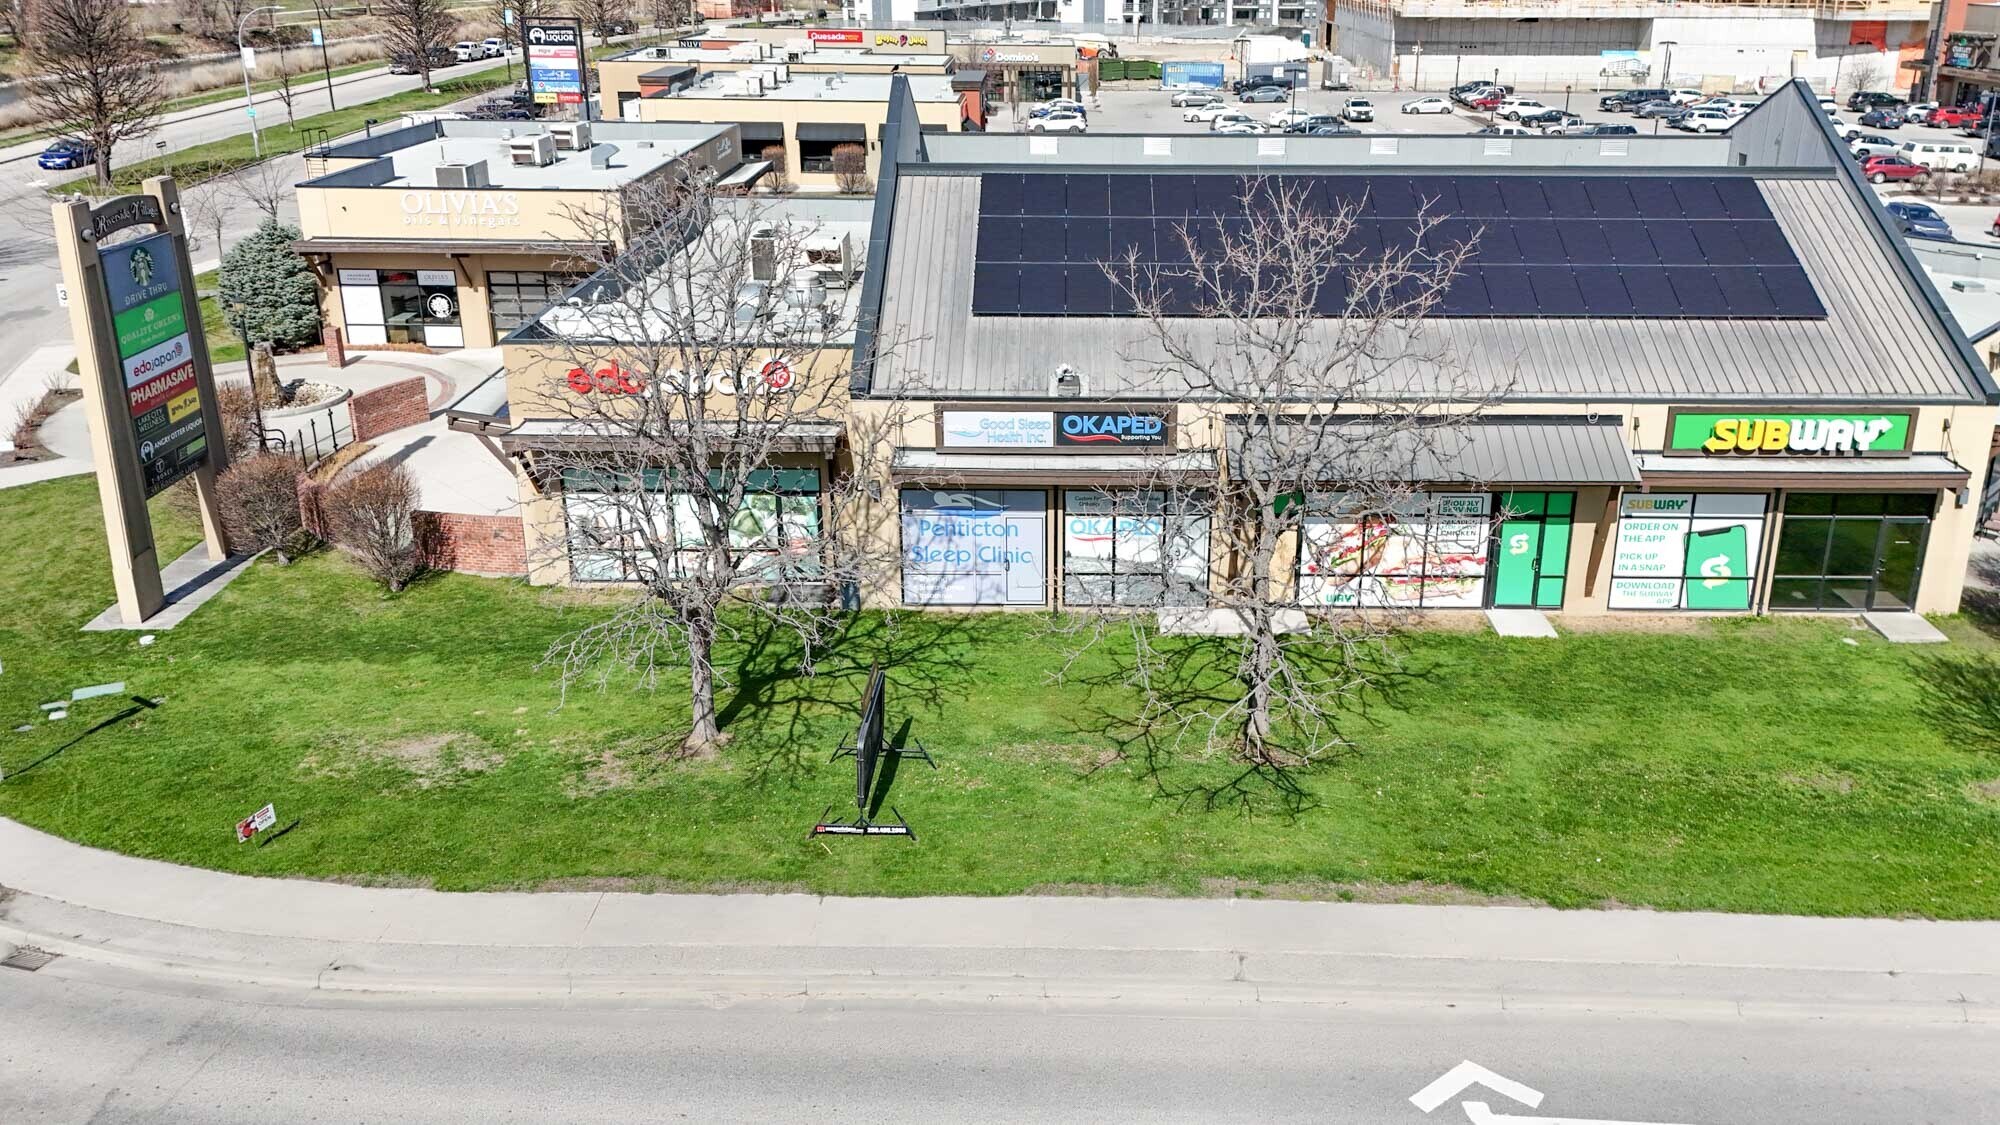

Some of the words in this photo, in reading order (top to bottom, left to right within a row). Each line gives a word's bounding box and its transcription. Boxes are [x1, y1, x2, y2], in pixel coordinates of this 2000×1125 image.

[810, 32, 846, 40] Quesada
[996, 52, 1040, 62] Domino's
[400, 192, 520, 215] OLIVIA'S
[96, 208, 132, 236] Riverside
[131, 201, 160, 221] Village
[402, 214, 432, 225] oils
[455, 215, 521, 229] vinegars
[125, 289, 148, 306] DRIVE
[150, 282, 168, 296] THRU
[130, 364, 194, 406] PHARMASAVE
[138, 415, 166, 433] WELLNESS
[154, 435, 171, 449] ANGRY
[170, 428, 186, 442] OTTER
[185, 416, 204, 434] LIQUOR
[979, 418, 1015, 431] Good
[1018, 418, 1051, 434] Sleep
[1062, 414, 1162, 434] OKAPED
[986, 430, 1024, 444] Health
[1026, 431, 1047, 444] Inc.
[1703, 417, 1894, 453] SUBWAY
[1626, 500, 1688, 510] SUBWAY
[919, 518, 1019, 538] Penticton
[1624, 522, 1660, 531] ORDER
[1662, 523, 1679, 531] ON
[1623, 534, 1644, 542] THE
[1644, 534, 1666, 542] APP
[912, 546, 971, 566] Sleep
[977, 545, 1032, 564] Clinic
[1620, 552, 1642, 560] PICK
[1645, 552, 1658, 560] UP
[1616, 582, 1675, 590] DOWNLOAD
